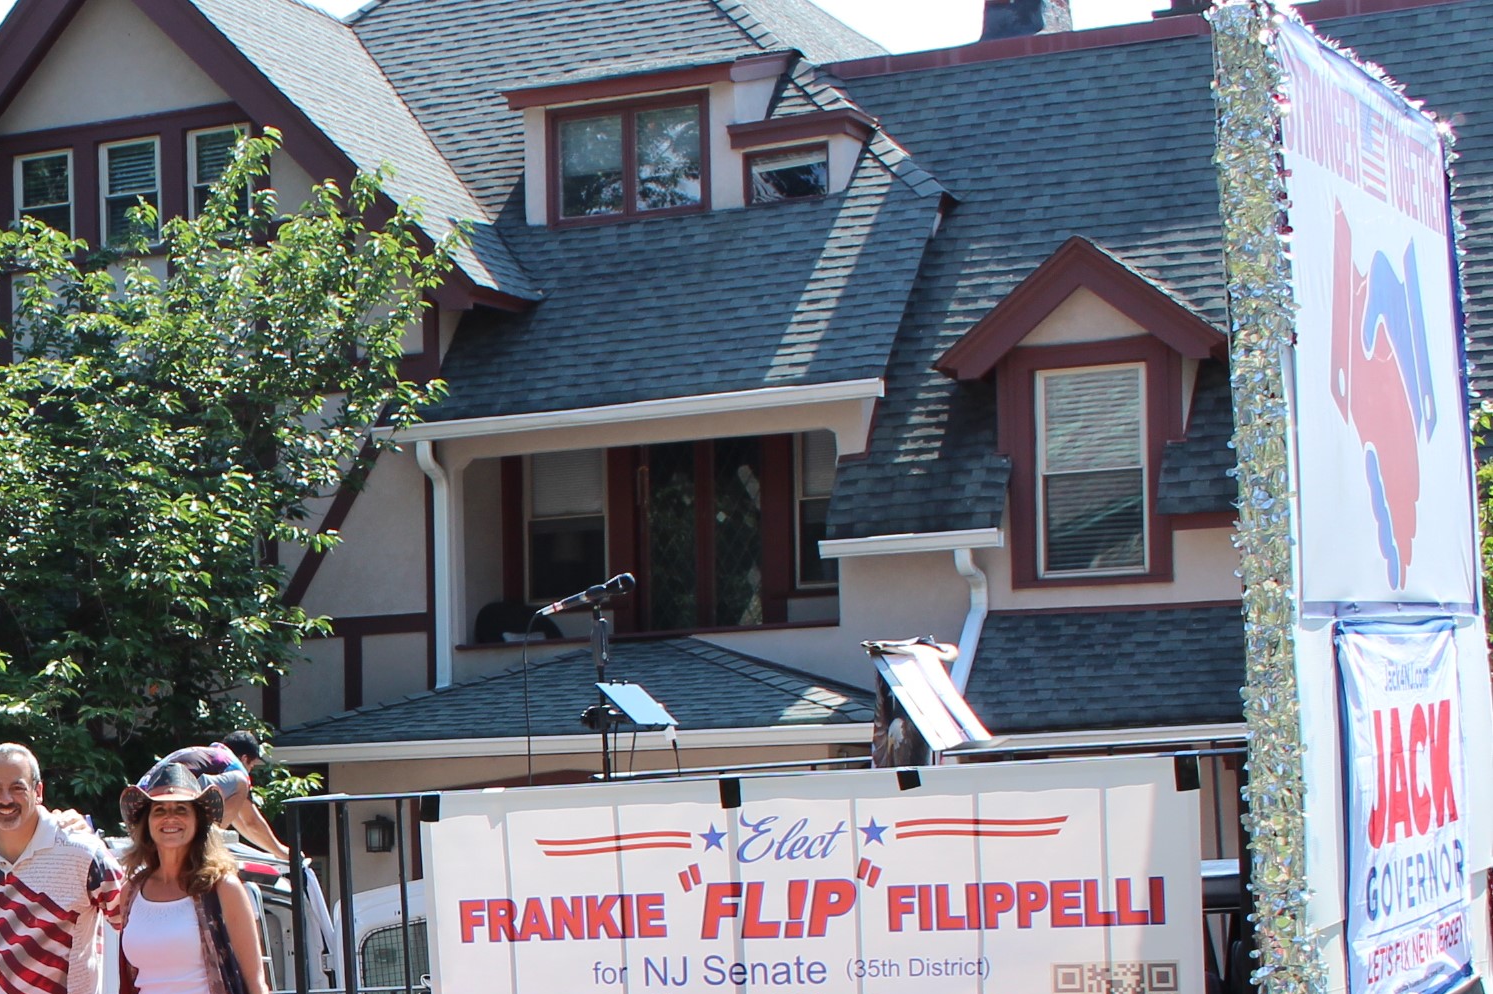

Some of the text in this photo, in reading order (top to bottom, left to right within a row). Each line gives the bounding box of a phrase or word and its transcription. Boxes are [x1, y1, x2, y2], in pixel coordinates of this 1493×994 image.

[1368, 699, 1458, 849] JACK
[736, 811, 849, 864] Elect
[459, 893, 667, 943] FRANKIE
[887, 876, 1166, 932] FILIPPELLI
[1366, 839, 1464, 921] GOVERNOR
[593, 955, 990, 986] for NJ Senate (35th District)
[1395, 942, 1411, 973] FIX
[1412, 930, 1434, 965] NEW
